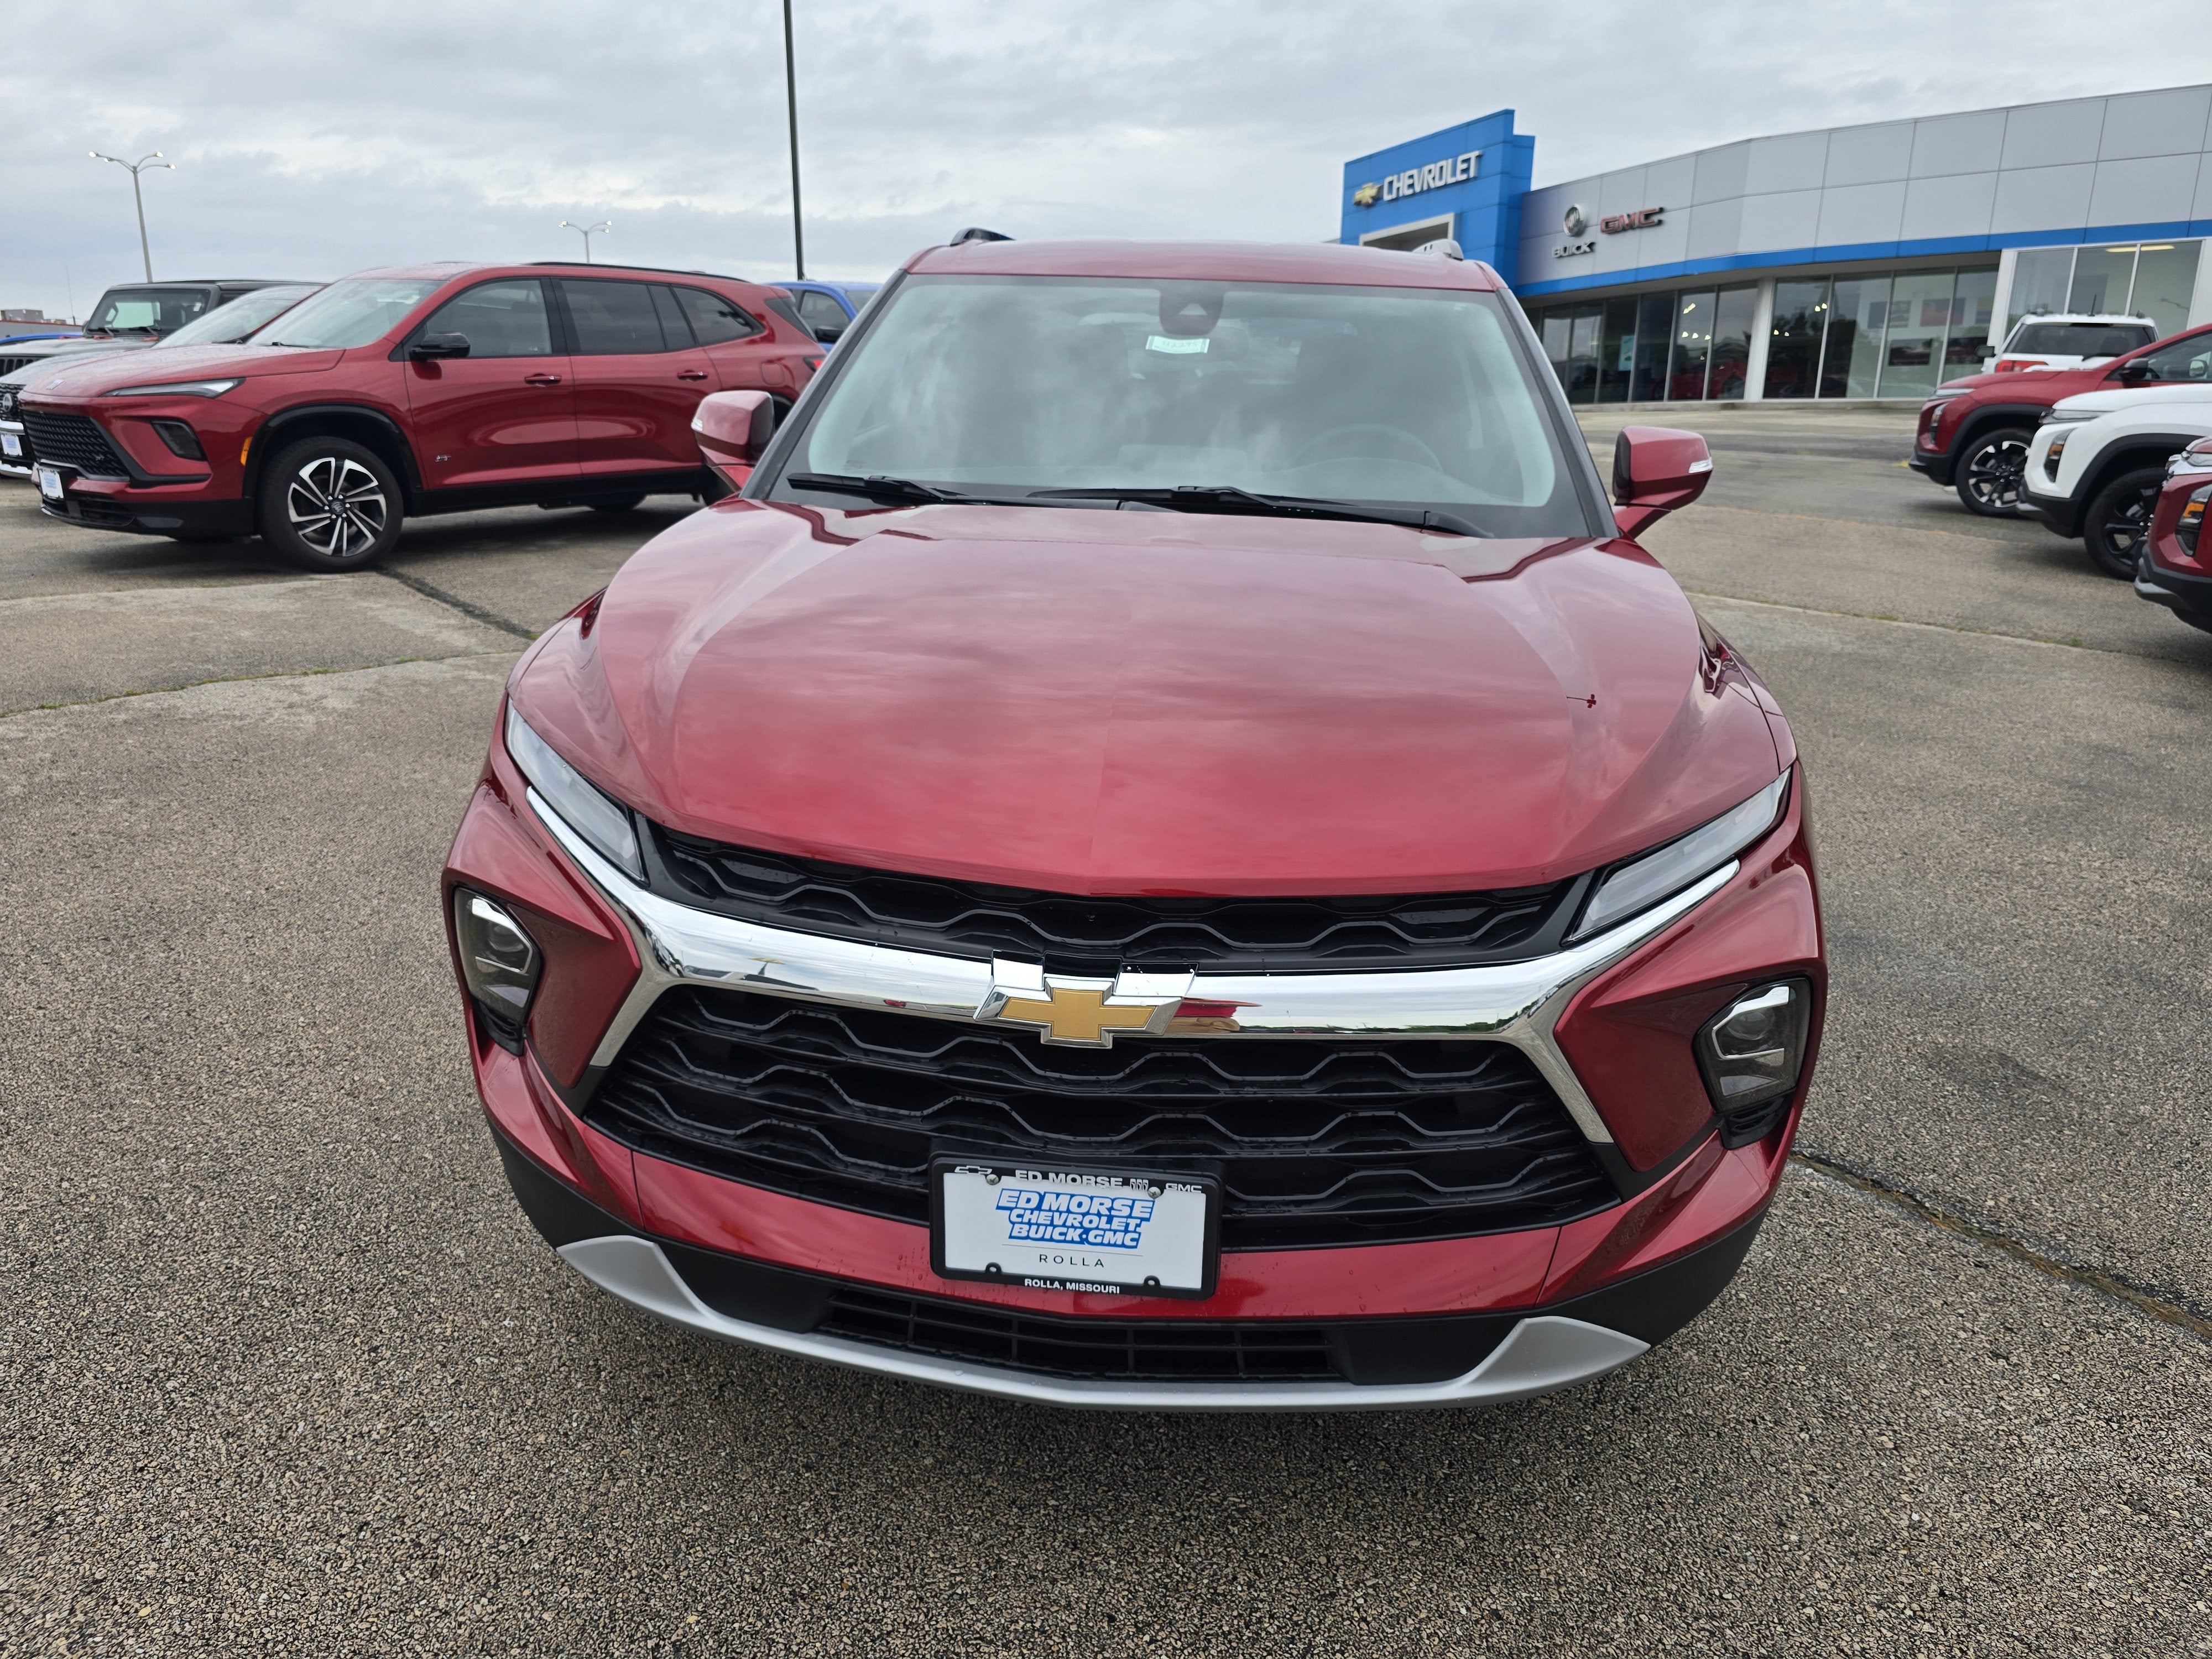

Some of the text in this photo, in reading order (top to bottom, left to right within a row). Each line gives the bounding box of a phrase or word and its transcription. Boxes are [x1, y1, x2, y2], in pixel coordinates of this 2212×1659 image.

[1383, 150, 1483, 201] CHEVROLET
[1600, 208, 1659, 234] GMC
[1552, 242, 1593, 258] BUICK
[1015, 1170, 1202, 1193] ED MORSE GMC
[998, 1190, 1154, 1218] ED MORSE
[1010, 1209, 1141, 1232] CHEVROLET
[1039, 1254, 1104, 1267] ROLLA
[1025, 1279, 1120, 1293] ROLLA, MISSOURI
